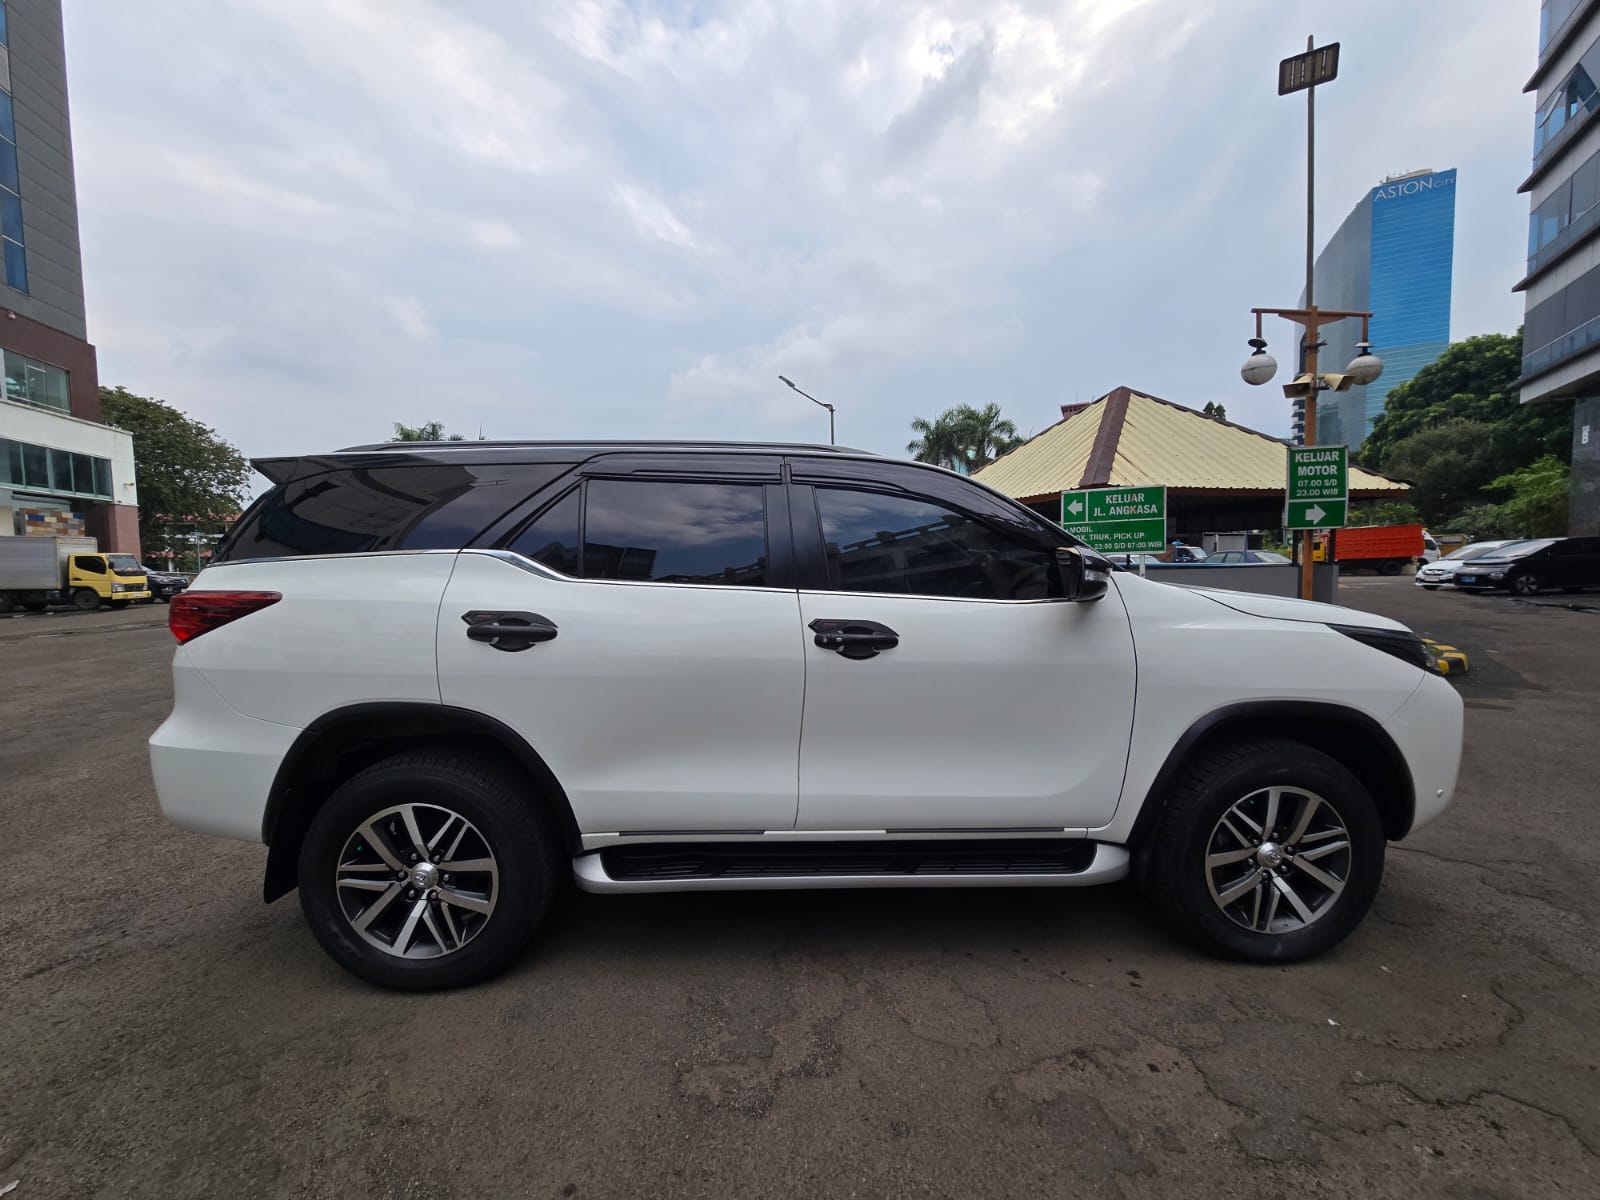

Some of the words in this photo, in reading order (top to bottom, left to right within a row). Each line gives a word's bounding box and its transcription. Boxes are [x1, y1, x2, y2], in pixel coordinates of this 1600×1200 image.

[1374, 177, 1433, 201] ASTON
[1433, 178, 1455, 188] CITY
[1295, 451, 1340, 463] KELUAR
[1297, 465, 1338, 476] MOTOR
[1105, 493, 1145, 504] KELUAR
[1093, 507, 1107, 517] JL.
[1109, 504, 1158, 516] ANGKASA
[1069, 526, 1093, 534] MOBIL
[1089, 533, 1112, 541] TRUK,
[1113, 532, 1132, 540] PICK
[1127, 541, 1146, 549] 07:00
